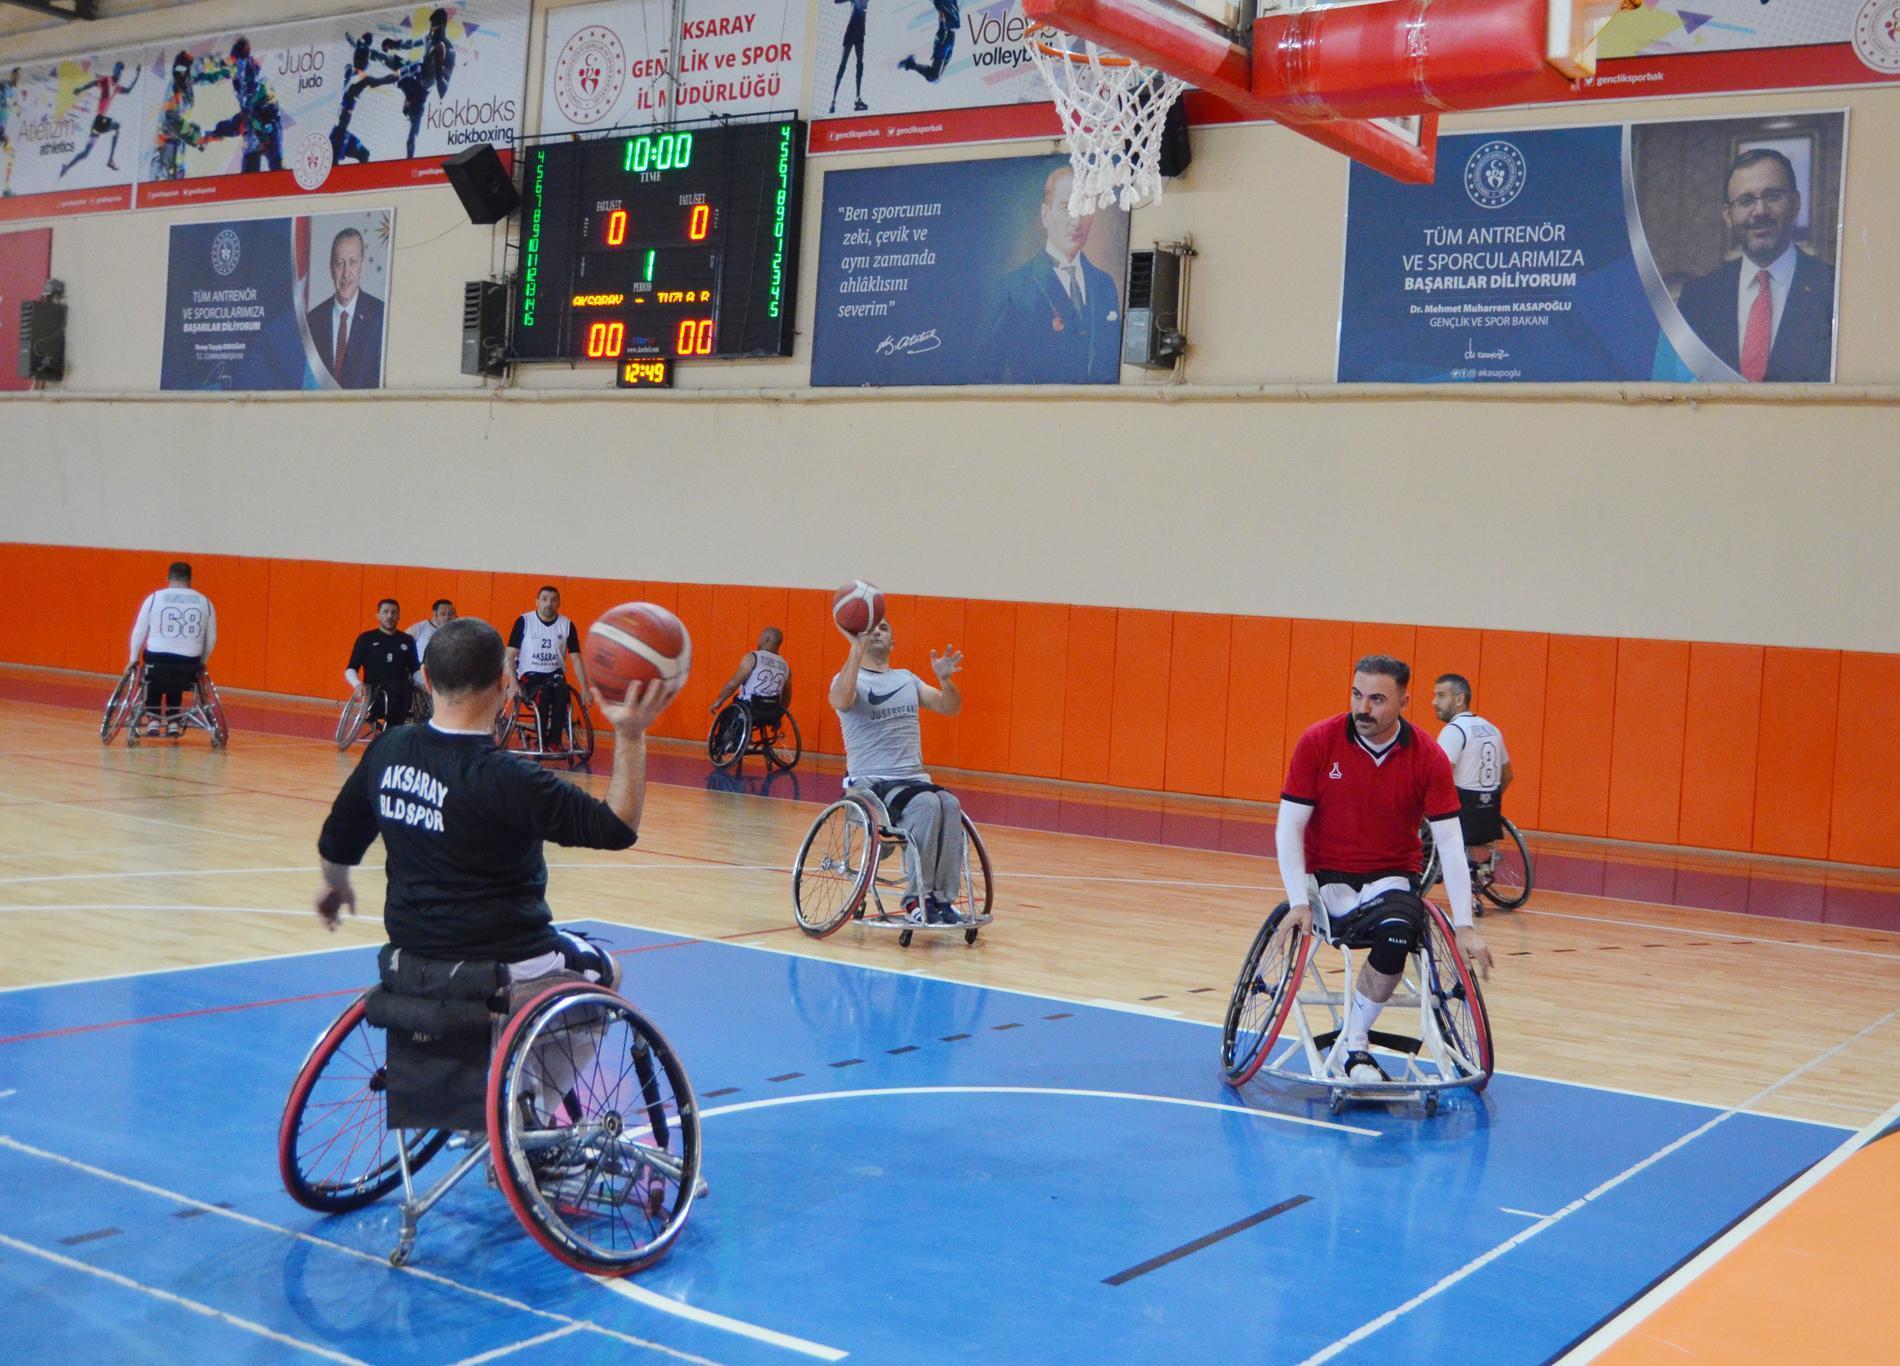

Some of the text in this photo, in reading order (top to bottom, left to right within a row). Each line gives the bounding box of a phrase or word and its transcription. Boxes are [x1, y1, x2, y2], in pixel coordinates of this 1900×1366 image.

[682, 14, 756, 40] KSARAY
[278, 45, 325, 76] Judo
[632, 43, 792, 78] GENLİK ve SPOR
[298, 75, 323, 93] judo
[1597, 73, 1664, 86] gencliksporbak
[637, 86, 653, 110] İL
[426, 95, 516, 129] kickboks
[447, 126, 514, 146] kickboxing
[624, 132, 693, 172] 10:00
[640, 171, 662, 183] TIME
[777, 190, 786, 205] 8
[690, 205, 709, 240] 0
[872, 202, 942, 223] sporcunun
[608, 211, 626, 245] 0
[843, 226, 928, 246] zeki, çevik ve
[1423, 222, 1566, 246] TÜM ANTRENÖR
[841, 249, 936, 274] aynı zamanda
[1402, 249, 1585, 272] VE SPORCULARIMIZA
[839, 275, 908, 294] ahlâklısını
[1404, 272, 1577, 293] BAŞARILAR DİLİYORUM
[193, 287, 257, 303] TÜM ANTRENÖR
[182, 308, 193, 320] VE
[1410, 300, 1572, 314] Dr. Mehmet Muharrem KASAPOĞLU
[1429, 315, 1549, 329] GENÇLİK VE SPOR BAKANI
[588, 322, 625, 357] 00
[677, 320, 713, 355] 00
[625, 363, 665, 383] 12:49
[160, 606, 202, 639] 68
[541, 638, 551, 649] 23
[1479, 741, 1497, 788] 8
[381, 764, 448, 808] AKSARAY
[380, 794, 445, 832] BLDSPOR
